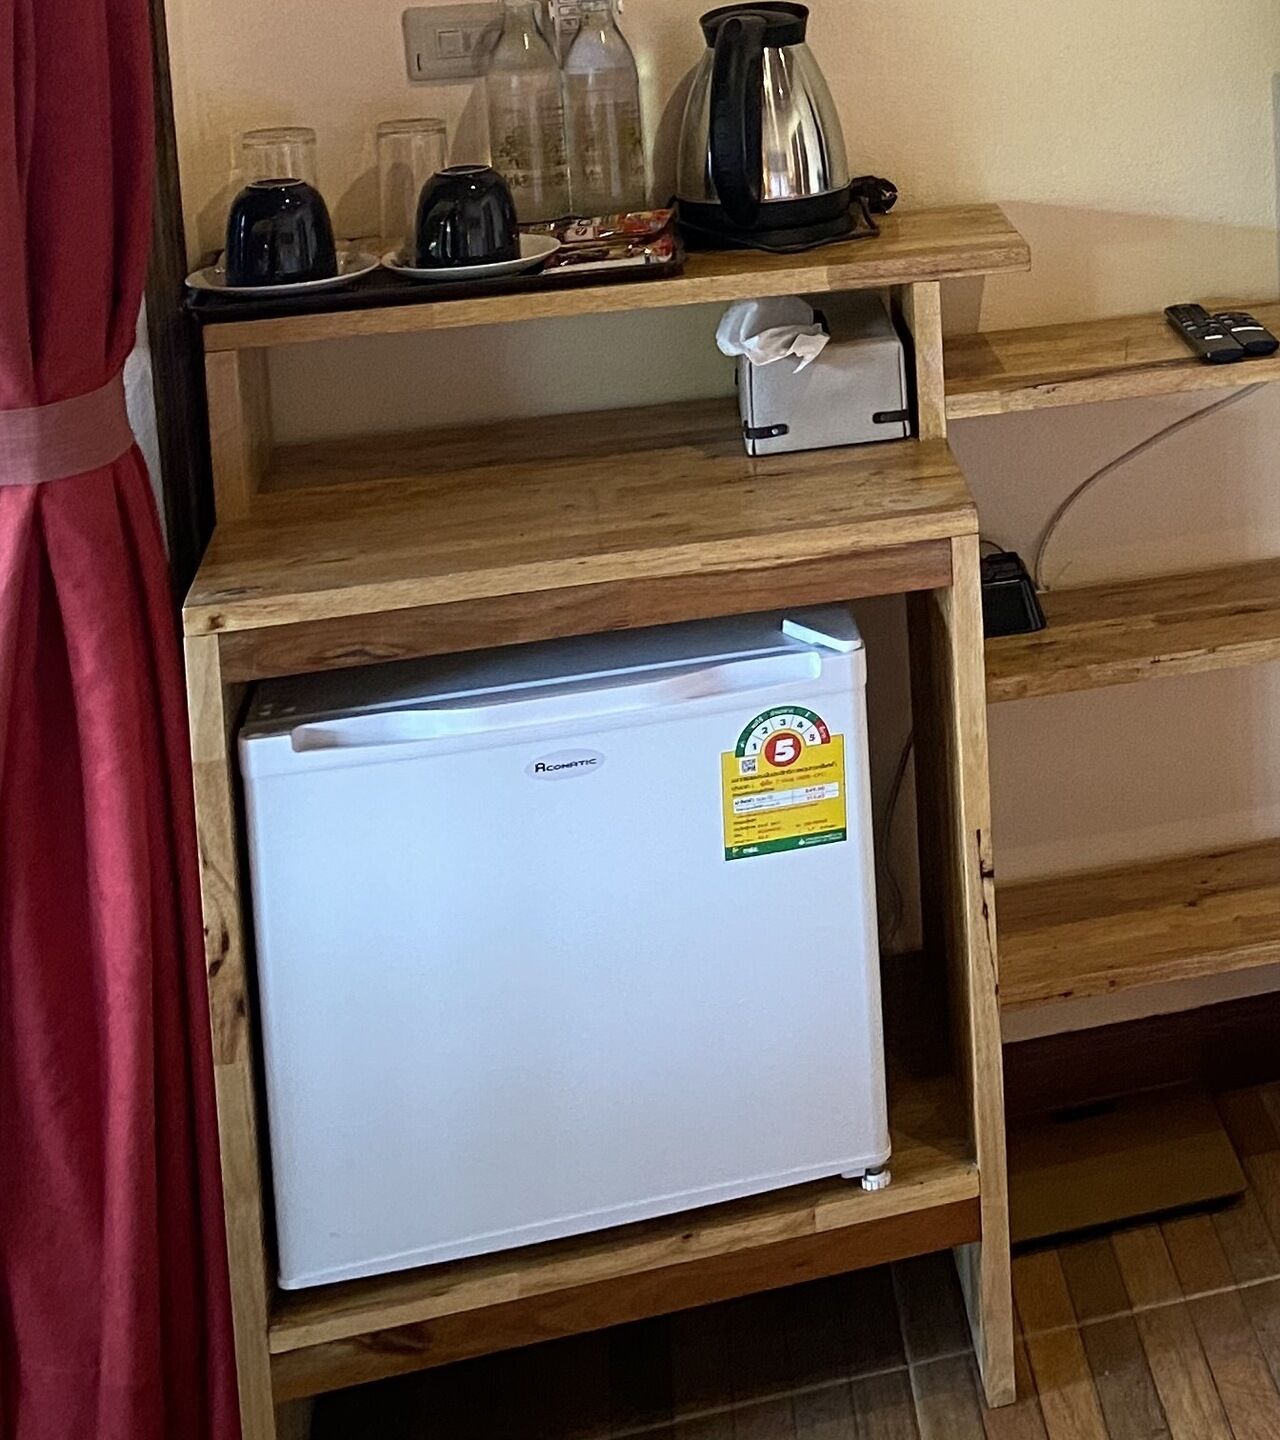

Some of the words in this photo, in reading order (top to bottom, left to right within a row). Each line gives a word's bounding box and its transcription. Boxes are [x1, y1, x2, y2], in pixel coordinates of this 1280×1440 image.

[761, 726, 769, 734] 2
[779, 718, 787, 727] 3
[796, 721, 804, 729] 4
[809, 733, 816, 742] 5
[773, 737, 796, 763] 5
